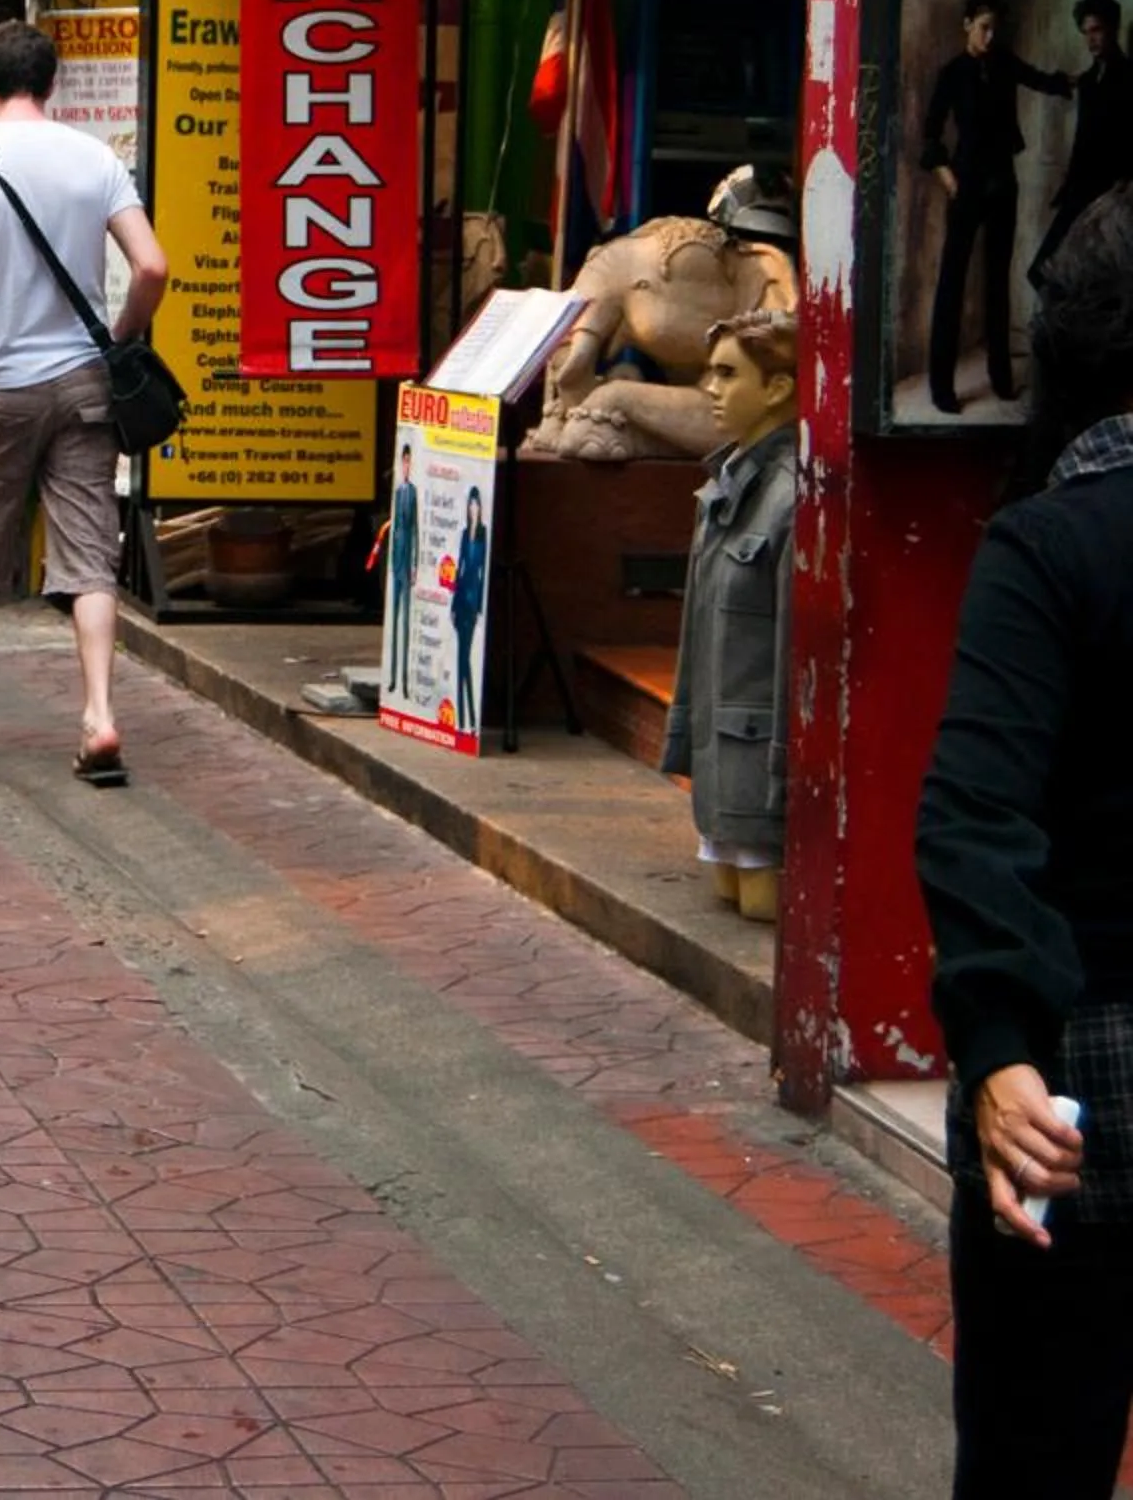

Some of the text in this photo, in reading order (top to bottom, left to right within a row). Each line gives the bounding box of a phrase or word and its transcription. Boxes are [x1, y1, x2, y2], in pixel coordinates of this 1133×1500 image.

[56, 17, 138, 40] EURO
[174, 113, 228, 136] Our
[194, 254, 229, 270] Visa
[202, 379, 324, 396] Diving Courses
[221, 403, 273, 418] much
[401, 389, 449, 426] EURO
[243, 449, 292, 462] Travel
